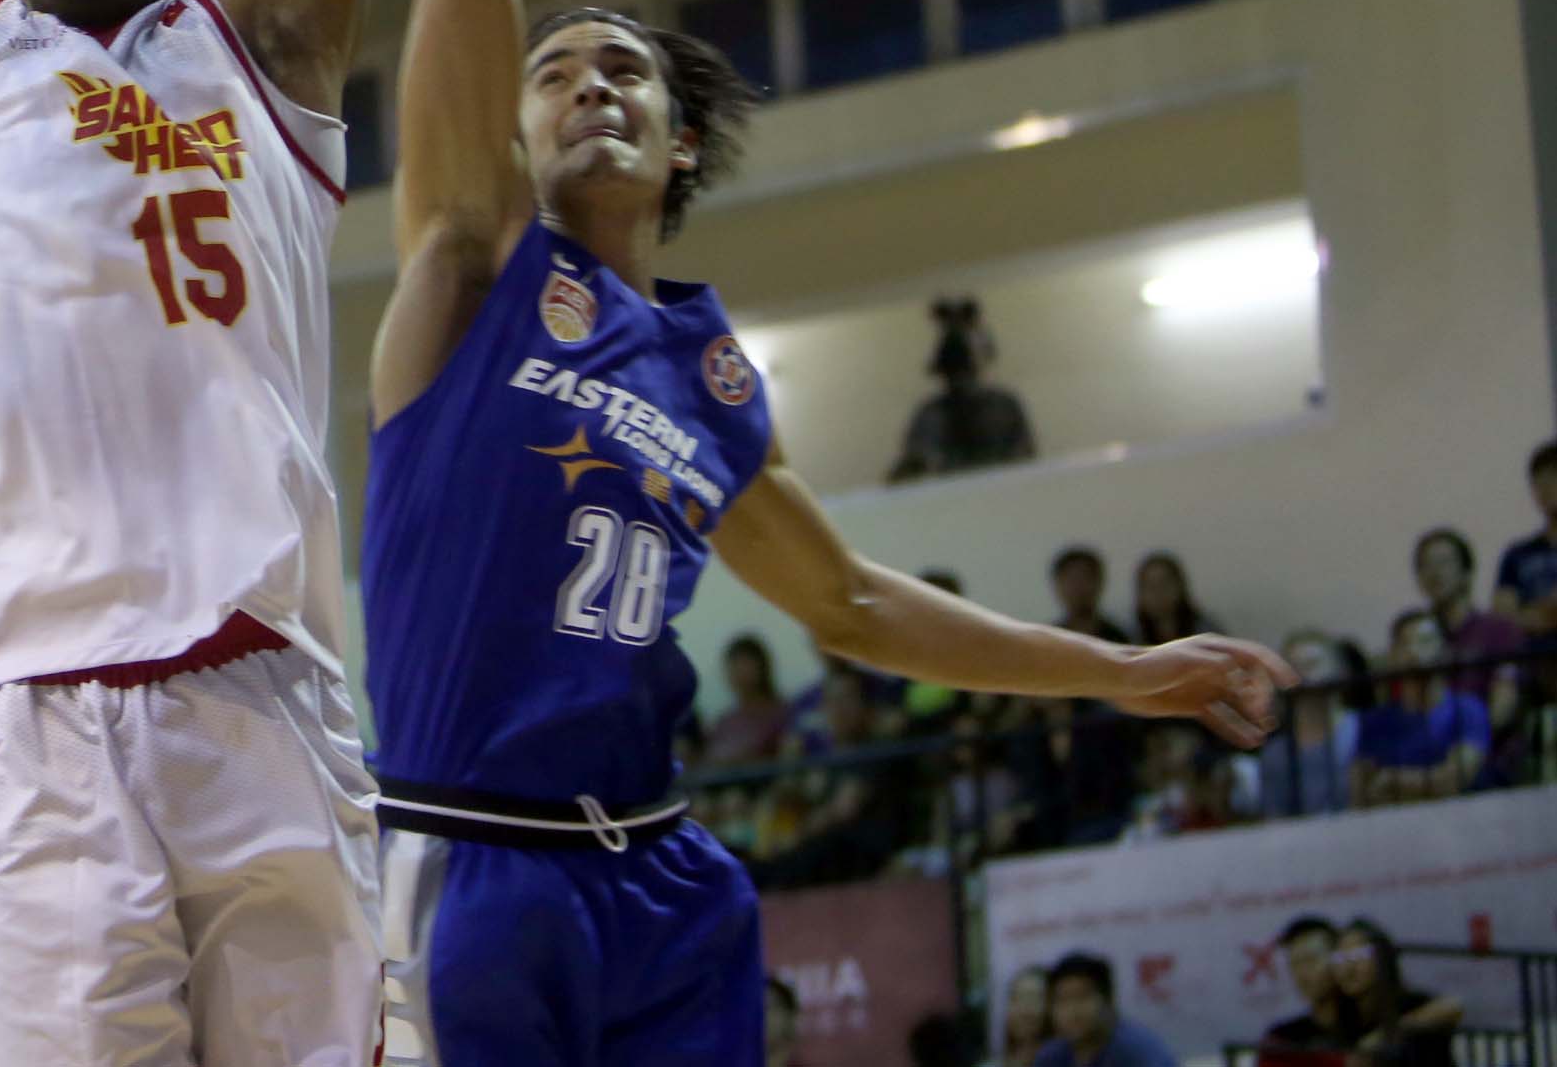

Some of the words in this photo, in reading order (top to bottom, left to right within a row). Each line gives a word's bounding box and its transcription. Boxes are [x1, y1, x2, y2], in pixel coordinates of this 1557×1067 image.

[131, 189, 247, 327] 15
[509, 357, 699, 462] EASTERN
[554, 505, 672, 647] 28
